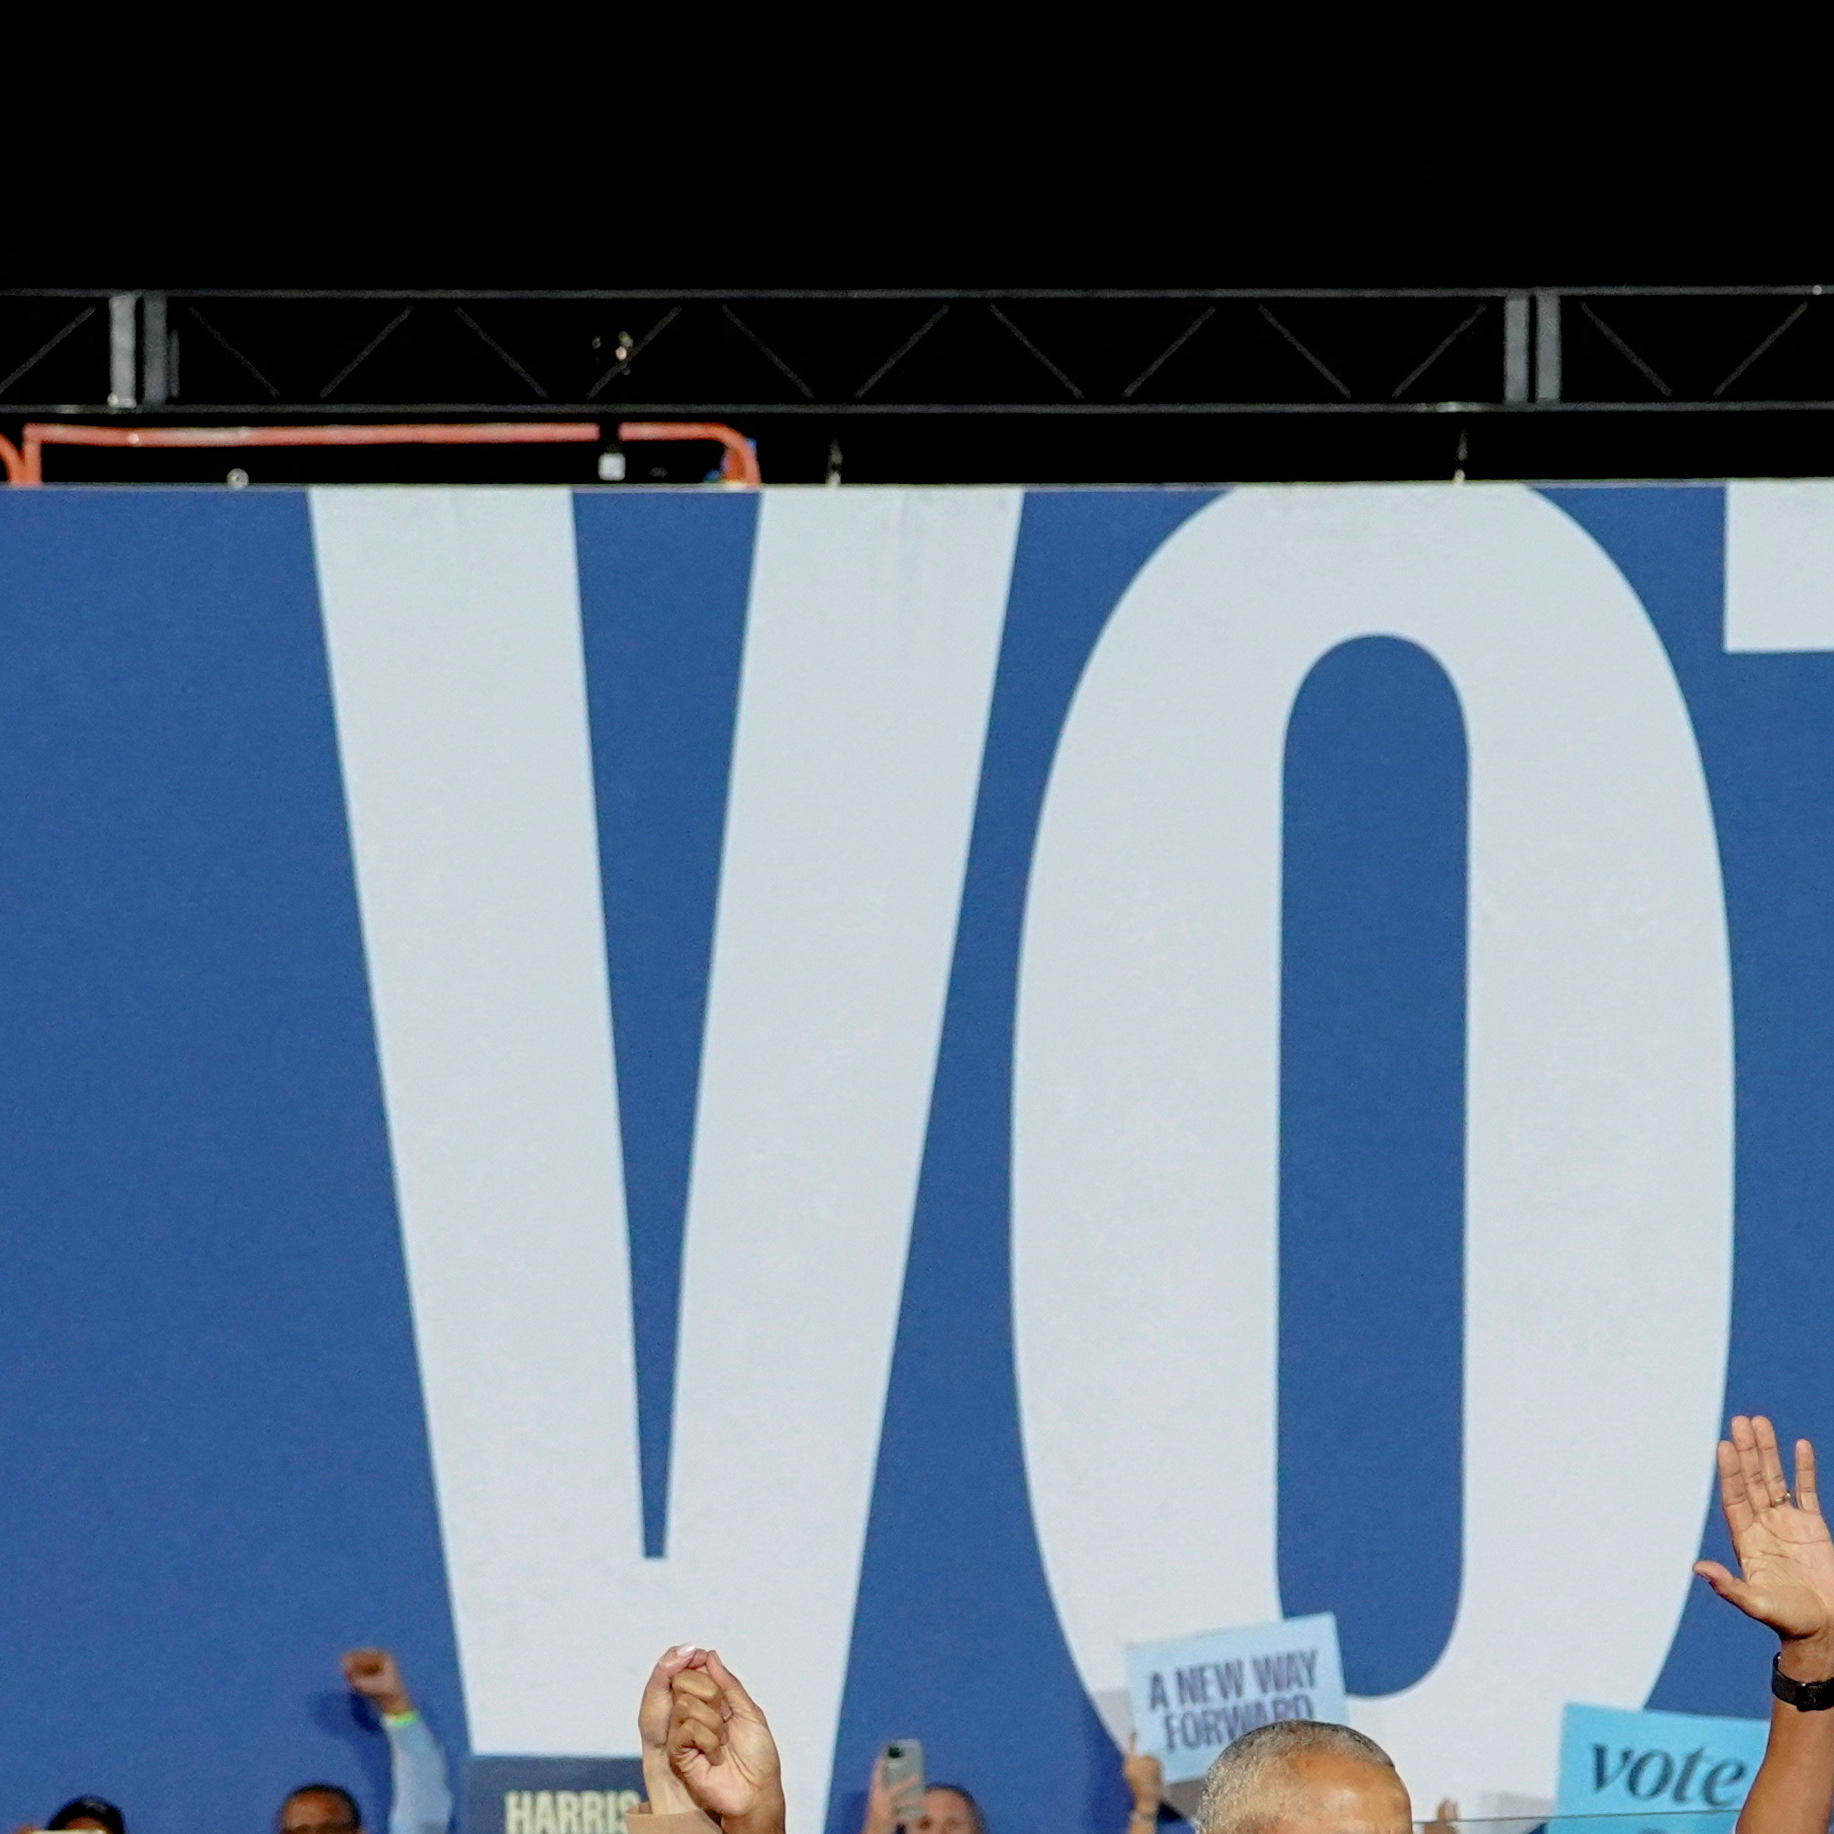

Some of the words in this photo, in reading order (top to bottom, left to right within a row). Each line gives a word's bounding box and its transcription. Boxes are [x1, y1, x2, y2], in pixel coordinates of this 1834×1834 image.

[1148, 1672, 1166, 1713] A
[1174, 1660, 1245, 1706] NEW
[1250, 1649, 1320, 1694] WAY
[1591, 1741, 1747, 1811] vote
